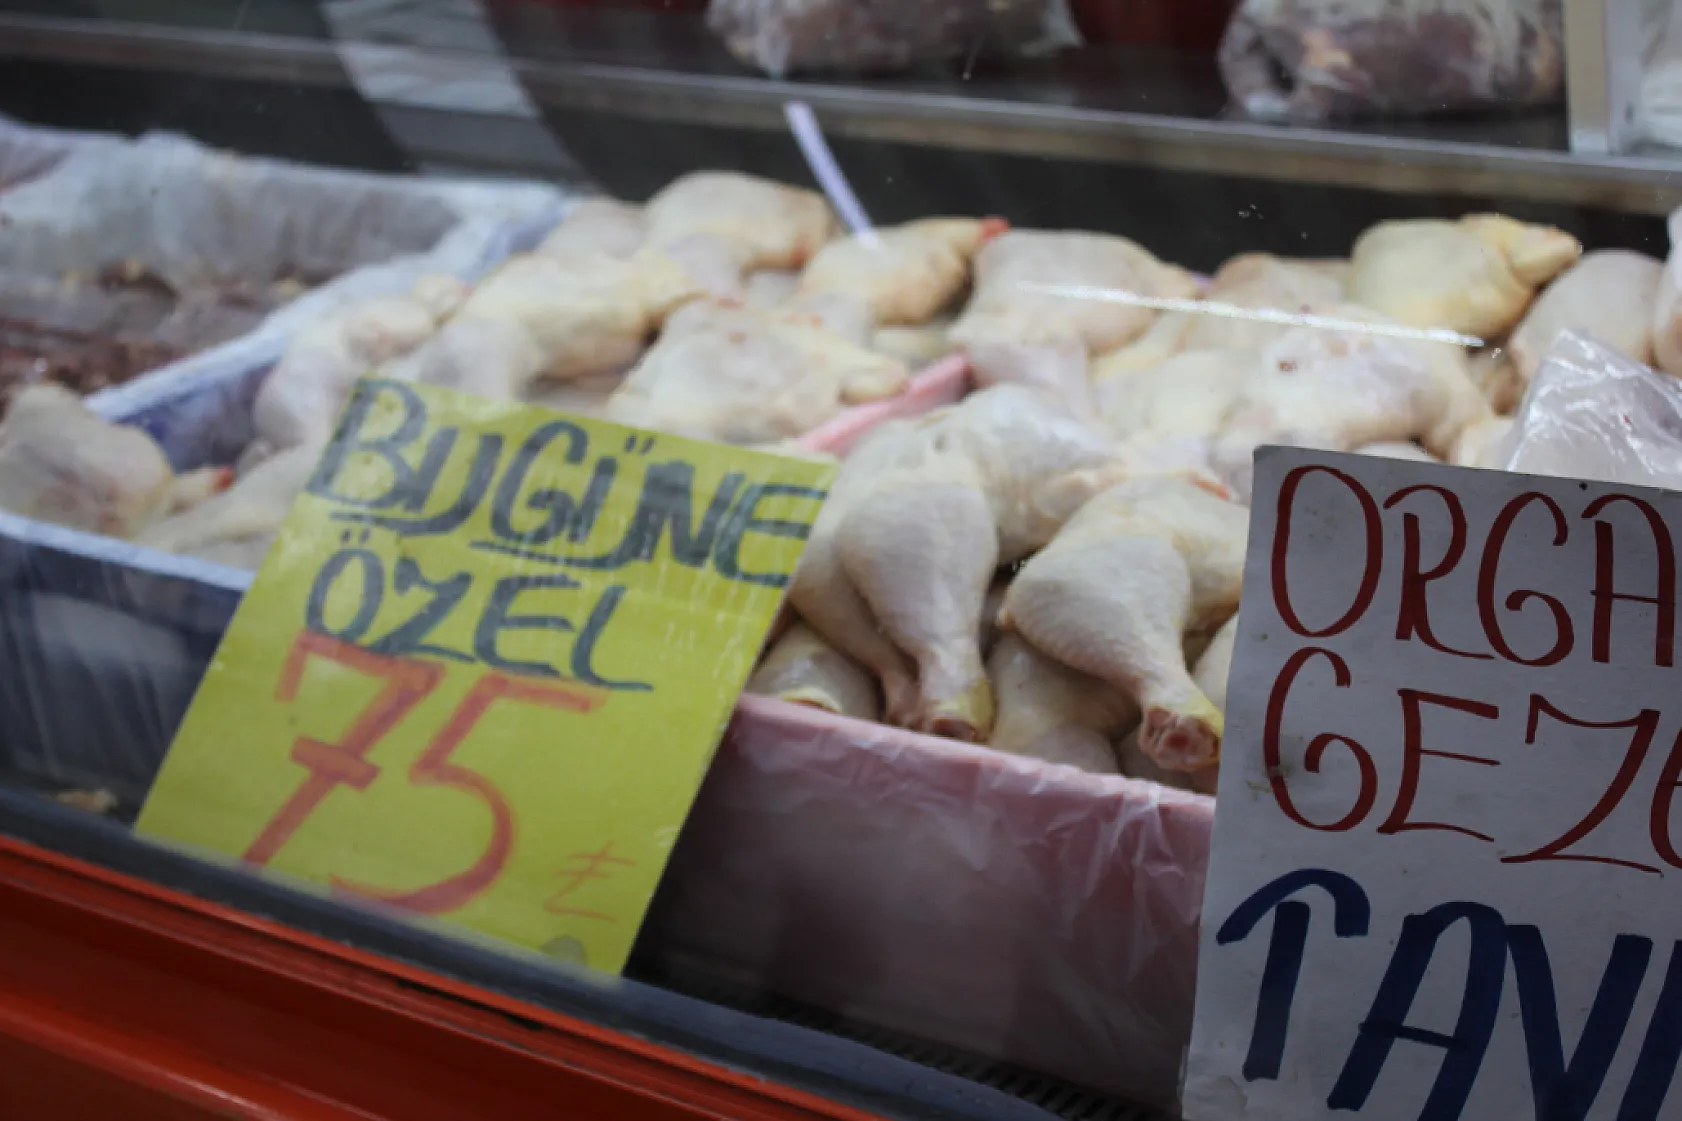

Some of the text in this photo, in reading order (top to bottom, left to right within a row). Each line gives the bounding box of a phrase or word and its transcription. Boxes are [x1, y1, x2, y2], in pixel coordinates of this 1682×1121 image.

[305, 378, 829, 589] BUGÜNE
[305, 528, 654, 692] ÖZEL
[239, 629, 606, 917] 75
